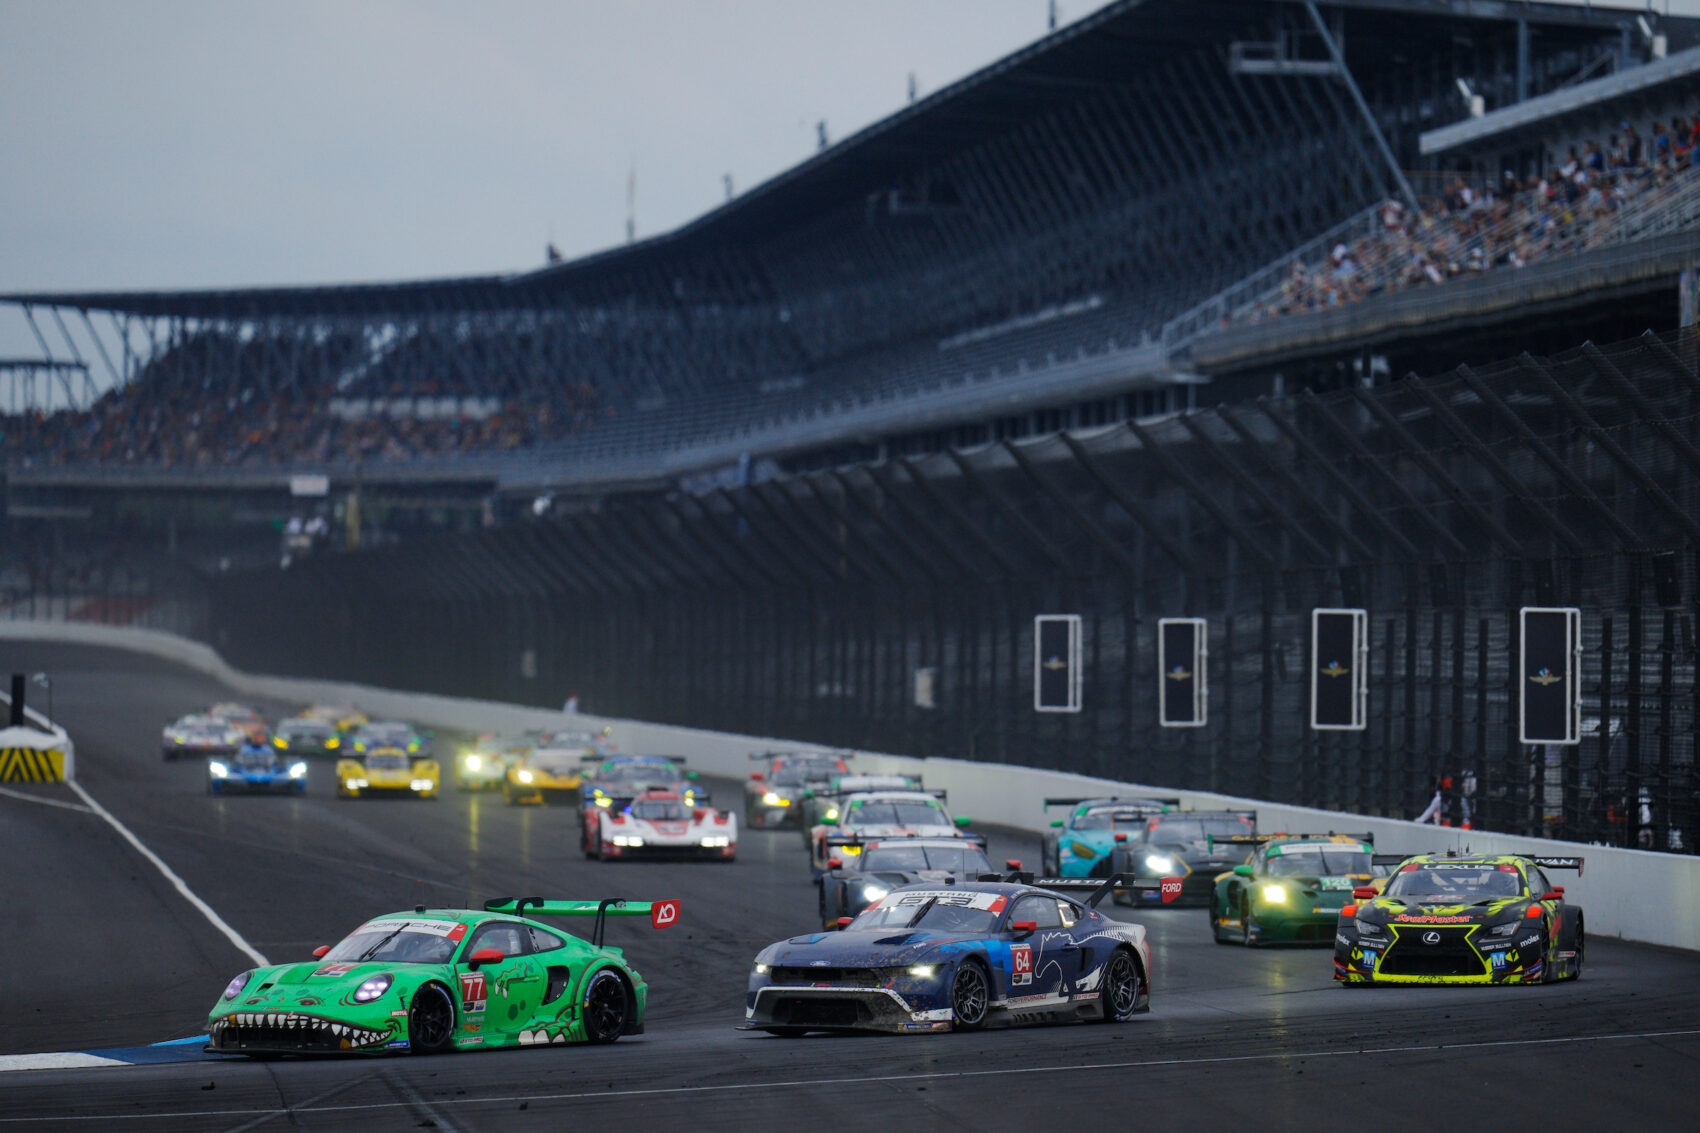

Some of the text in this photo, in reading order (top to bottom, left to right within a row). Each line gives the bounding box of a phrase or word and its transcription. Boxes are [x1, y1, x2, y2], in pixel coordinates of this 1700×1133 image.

[1162, 882, 1182, 893] FORD
[1395, 914, 1471, 924] SealMaster
[1520, 934, 1540, 947] molex
[1016, 951, 1030, 971] 64
[464, 978, 483, 1000] 77
